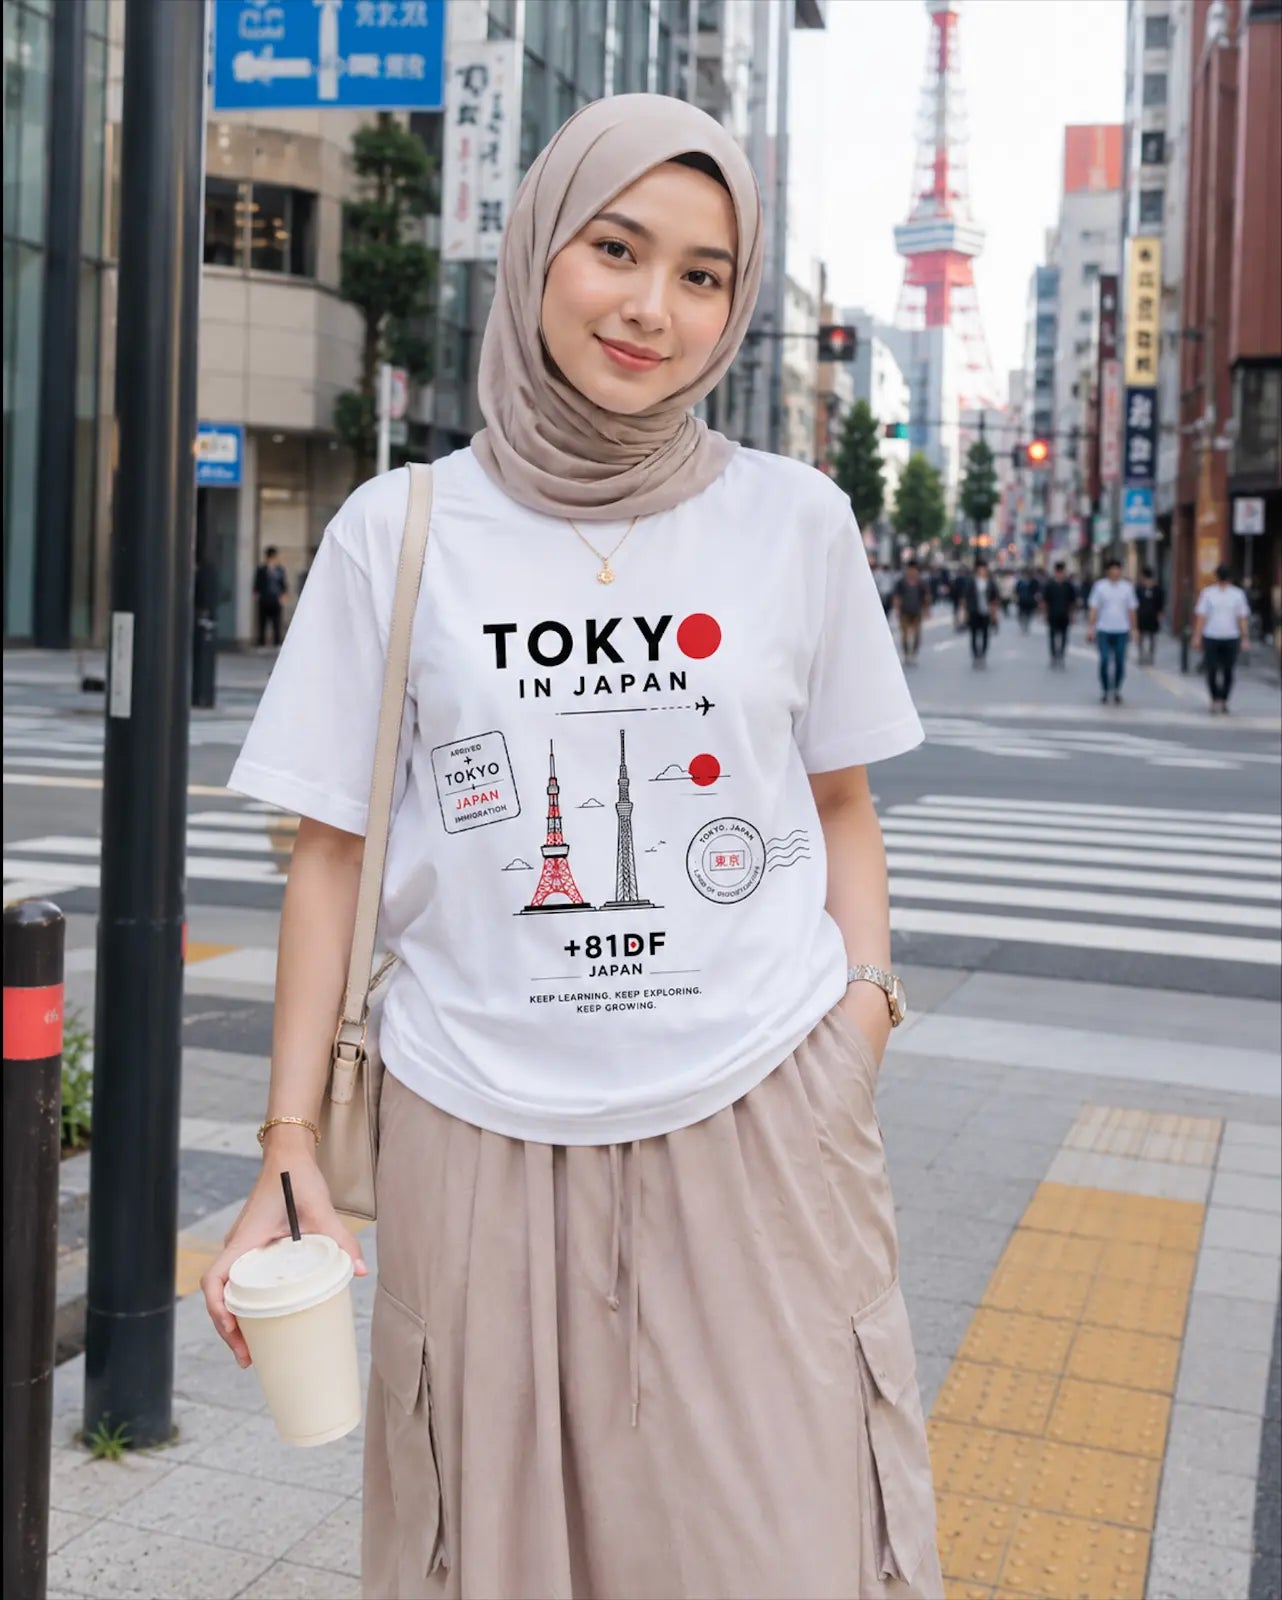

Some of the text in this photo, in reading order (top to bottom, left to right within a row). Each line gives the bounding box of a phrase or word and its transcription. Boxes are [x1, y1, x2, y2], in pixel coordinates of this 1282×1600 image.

[519, 671, 687, 699] IN JAPAN
[445, 762, 500, 786] TOKYO
[456, 789, 500, 810] JAPAN
[715, 854, 740, 867] 東京
[564, 932, 666, 959] +81DF
[589, 963, 643, 977] JAPAN
[529, 986, 703, 1004] KEEP LEARNING. KEEP EXPLORING.
[577, 1001, 657, 1013] KEEP GROWING.
